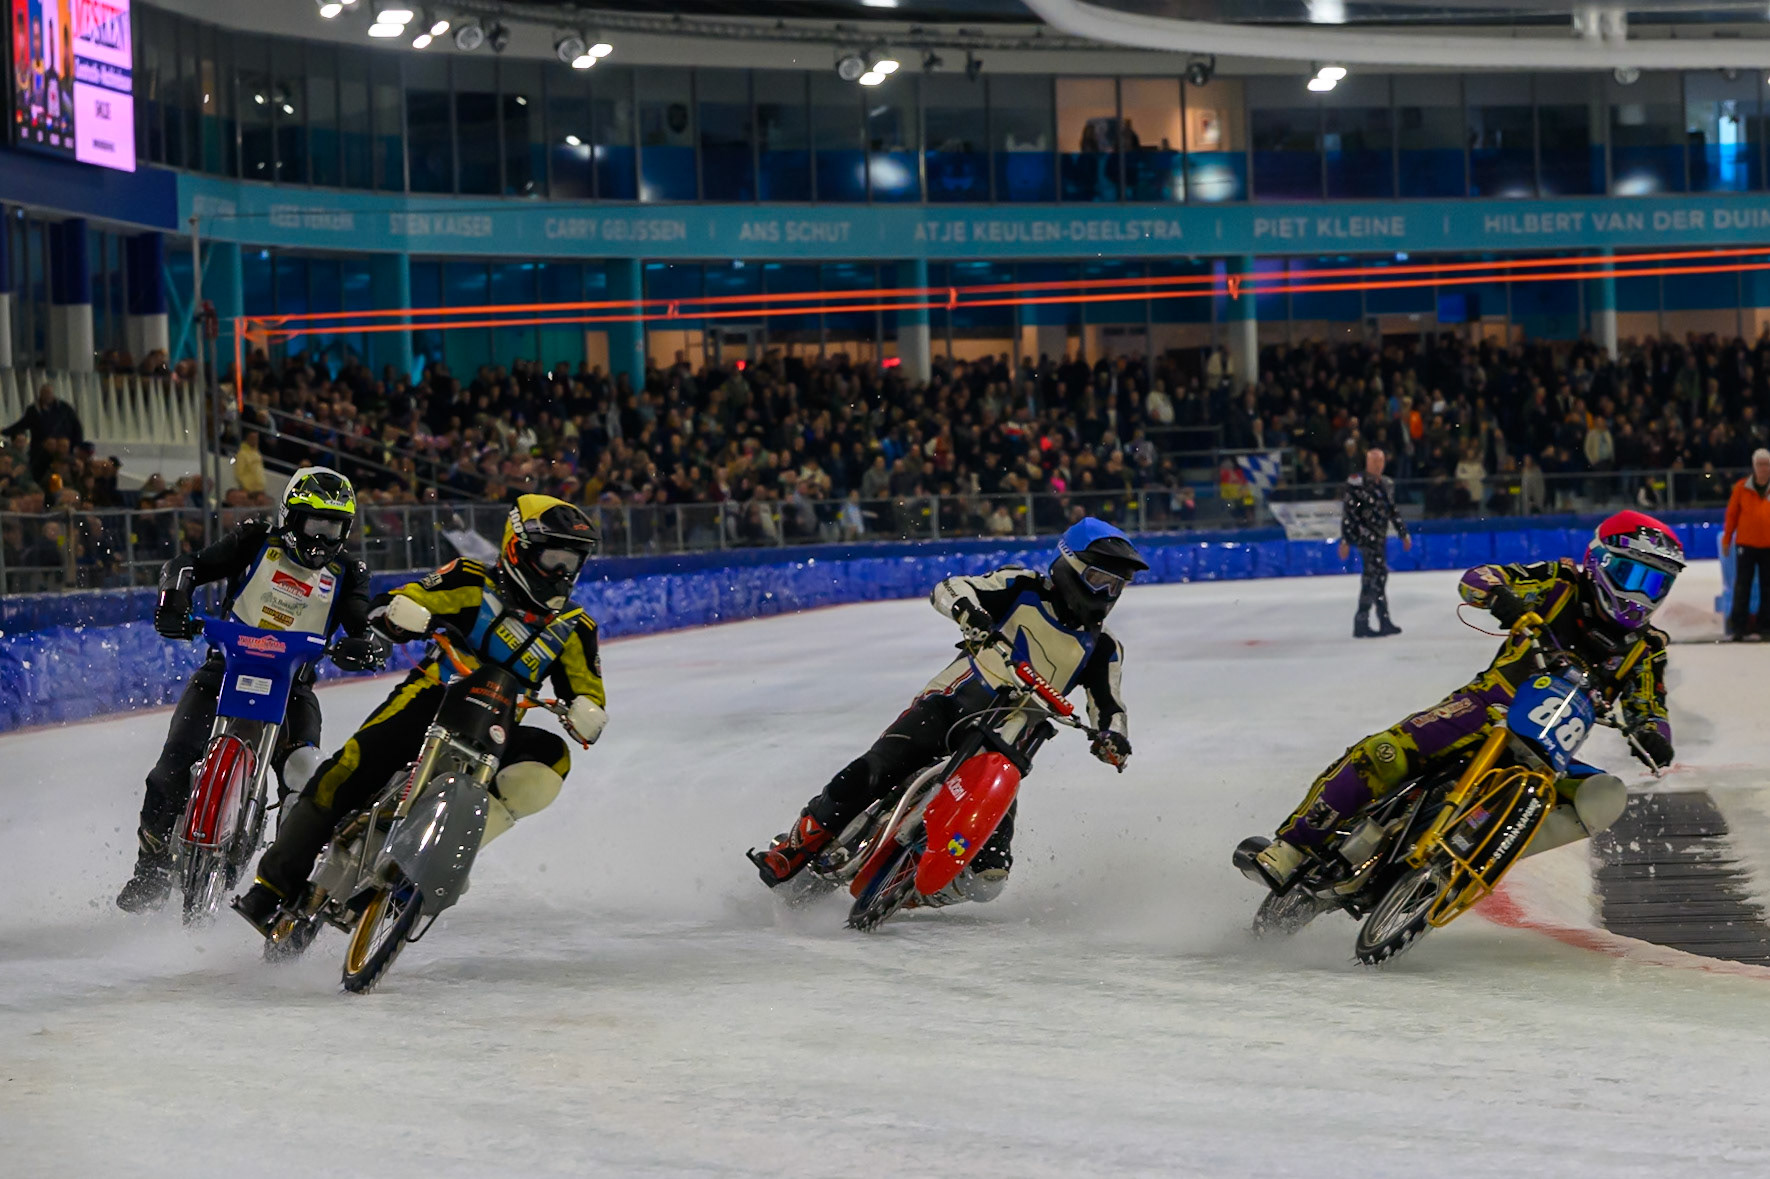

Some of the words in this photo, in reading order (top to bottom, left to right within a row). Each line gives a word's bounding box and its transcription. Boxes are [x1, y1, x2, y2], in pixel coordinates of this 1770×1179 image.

[739, 221, 779, 241] ANS
[785, 221, 850, 241] SCHUT
[913, 221, 966, 242] ATJE
[972, 220, 1183, 242] KEULEN-DEELSTRA
[1254, 217, 1307, 238] PIET
[1316, 216, 1406, 237] KLEINE
[1484, 212, 1585, 234] HILBERT
[1590, 211, 1644, 232] VAN
[1652, 210, 1705, 231] DER
[1527, 696, 1586, 752] 88
